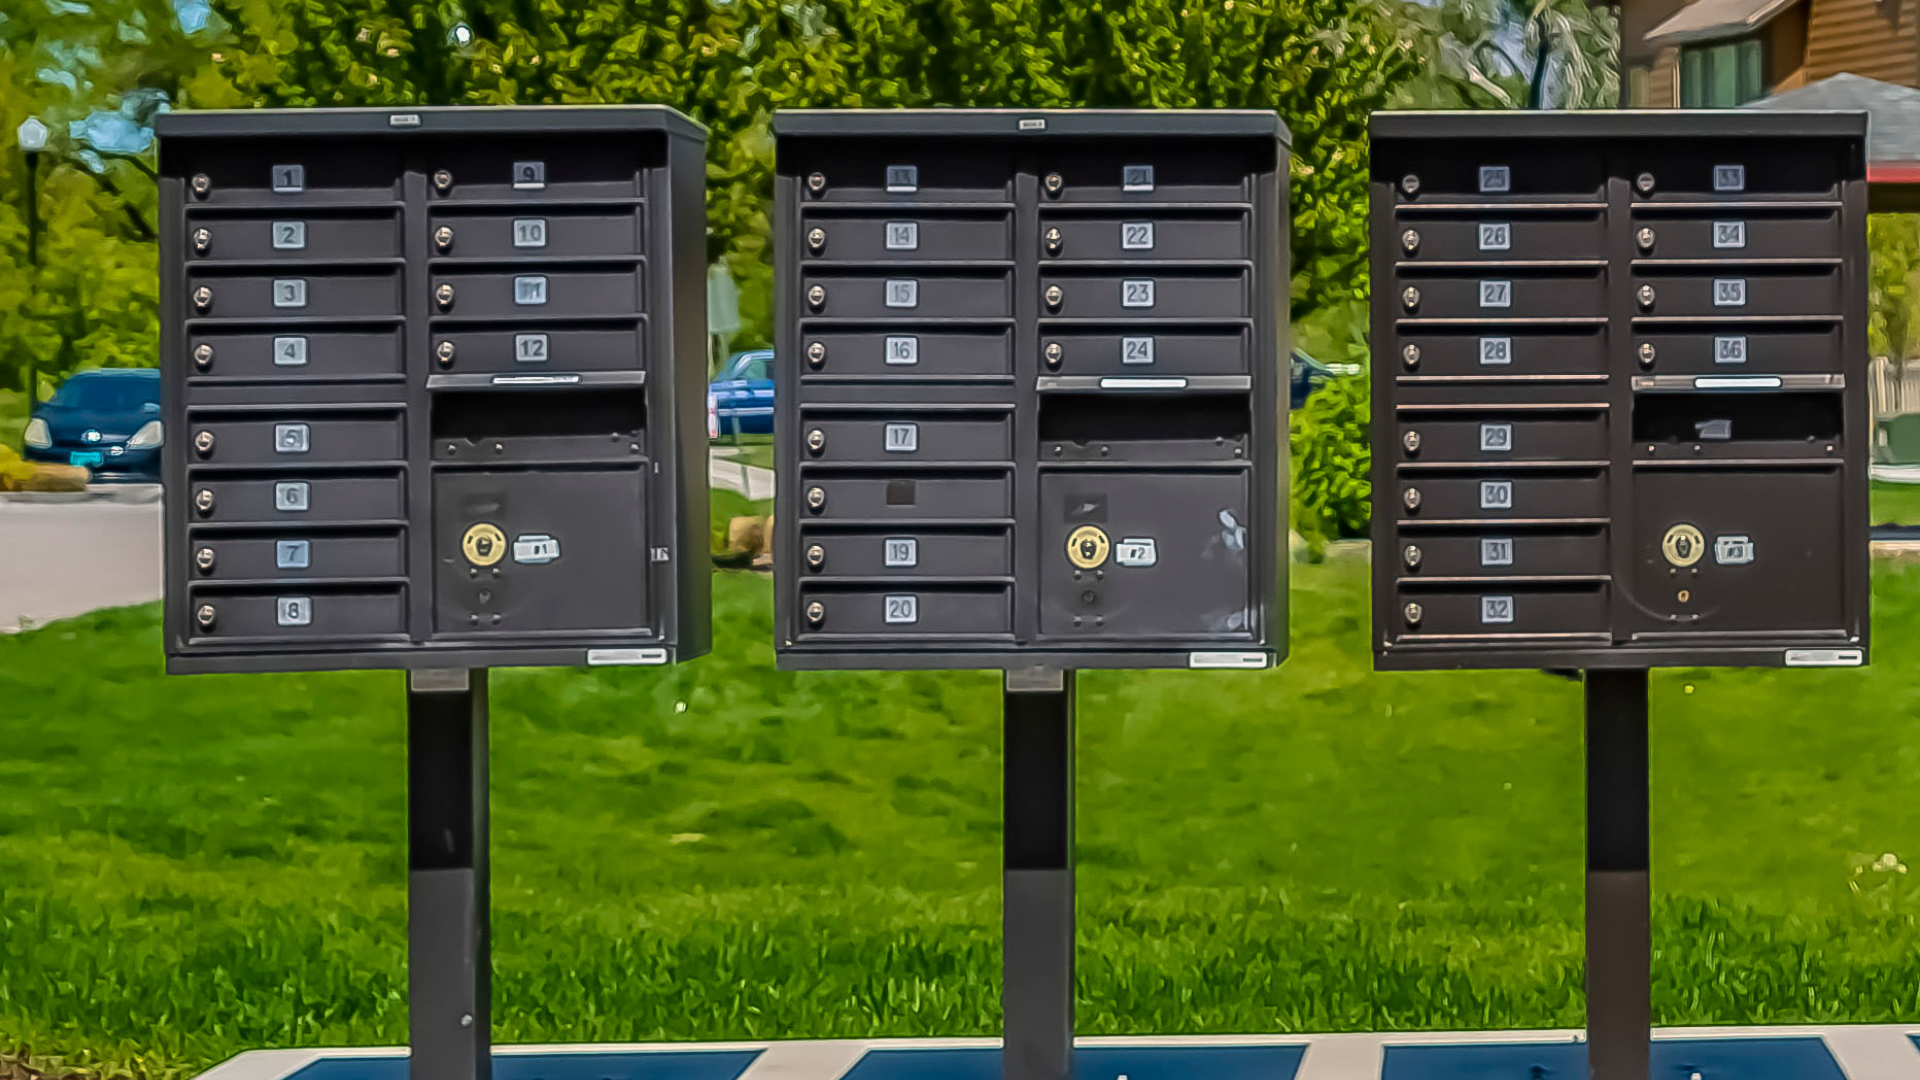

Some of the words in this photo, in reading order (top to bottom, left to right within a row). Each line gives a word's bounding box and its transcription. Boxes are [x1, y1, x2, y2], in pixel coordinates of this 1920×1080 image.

[283, 170, 293, 187] 1
[522, 166, 535, 181] 9
[1131, 169, 1147, 183] 21
[283, 226, 295, 244] 2
[519, 225, 542, 241] 10
[894, 227, 910, 243] 14
[1127, 226, 1148, 245] 22
[1483, 227, 1506, 246] 26
[1718, 225, 1740, 244] 34
[285, 285, 295, 301] 3
[894, 284, 910, 302] 15
[1127, 284, 1149, 303] 23
[1484, 284, 1507, 303] 27
[1718, 283, 1742, 302] 35
[284, 343, 296, 358] 4
[520, 340, 544, 357] 12
[895, 341, 910, 360] 16
[1127, 341, 1148, 359] 24
[1484, 341, 1507, 360] 28
[1719, 340, 1742, 359] 36
[285, 429, 298, 445] 5
[894, 428, 910, 445] 17
[1485, 427, 1507, 446] 29
[286, 488, 298, 504] 6
[1485, 485, 1508, 504] 30
[286, 545, 299, 561] 7
[893, 543, 909, 561] 19
[1490, 542, 1506, 561] 31
[287, 602, 299, 619] 8
[890, 599, 912, 618] 20
[1486, 600, 1509, 619] 32
